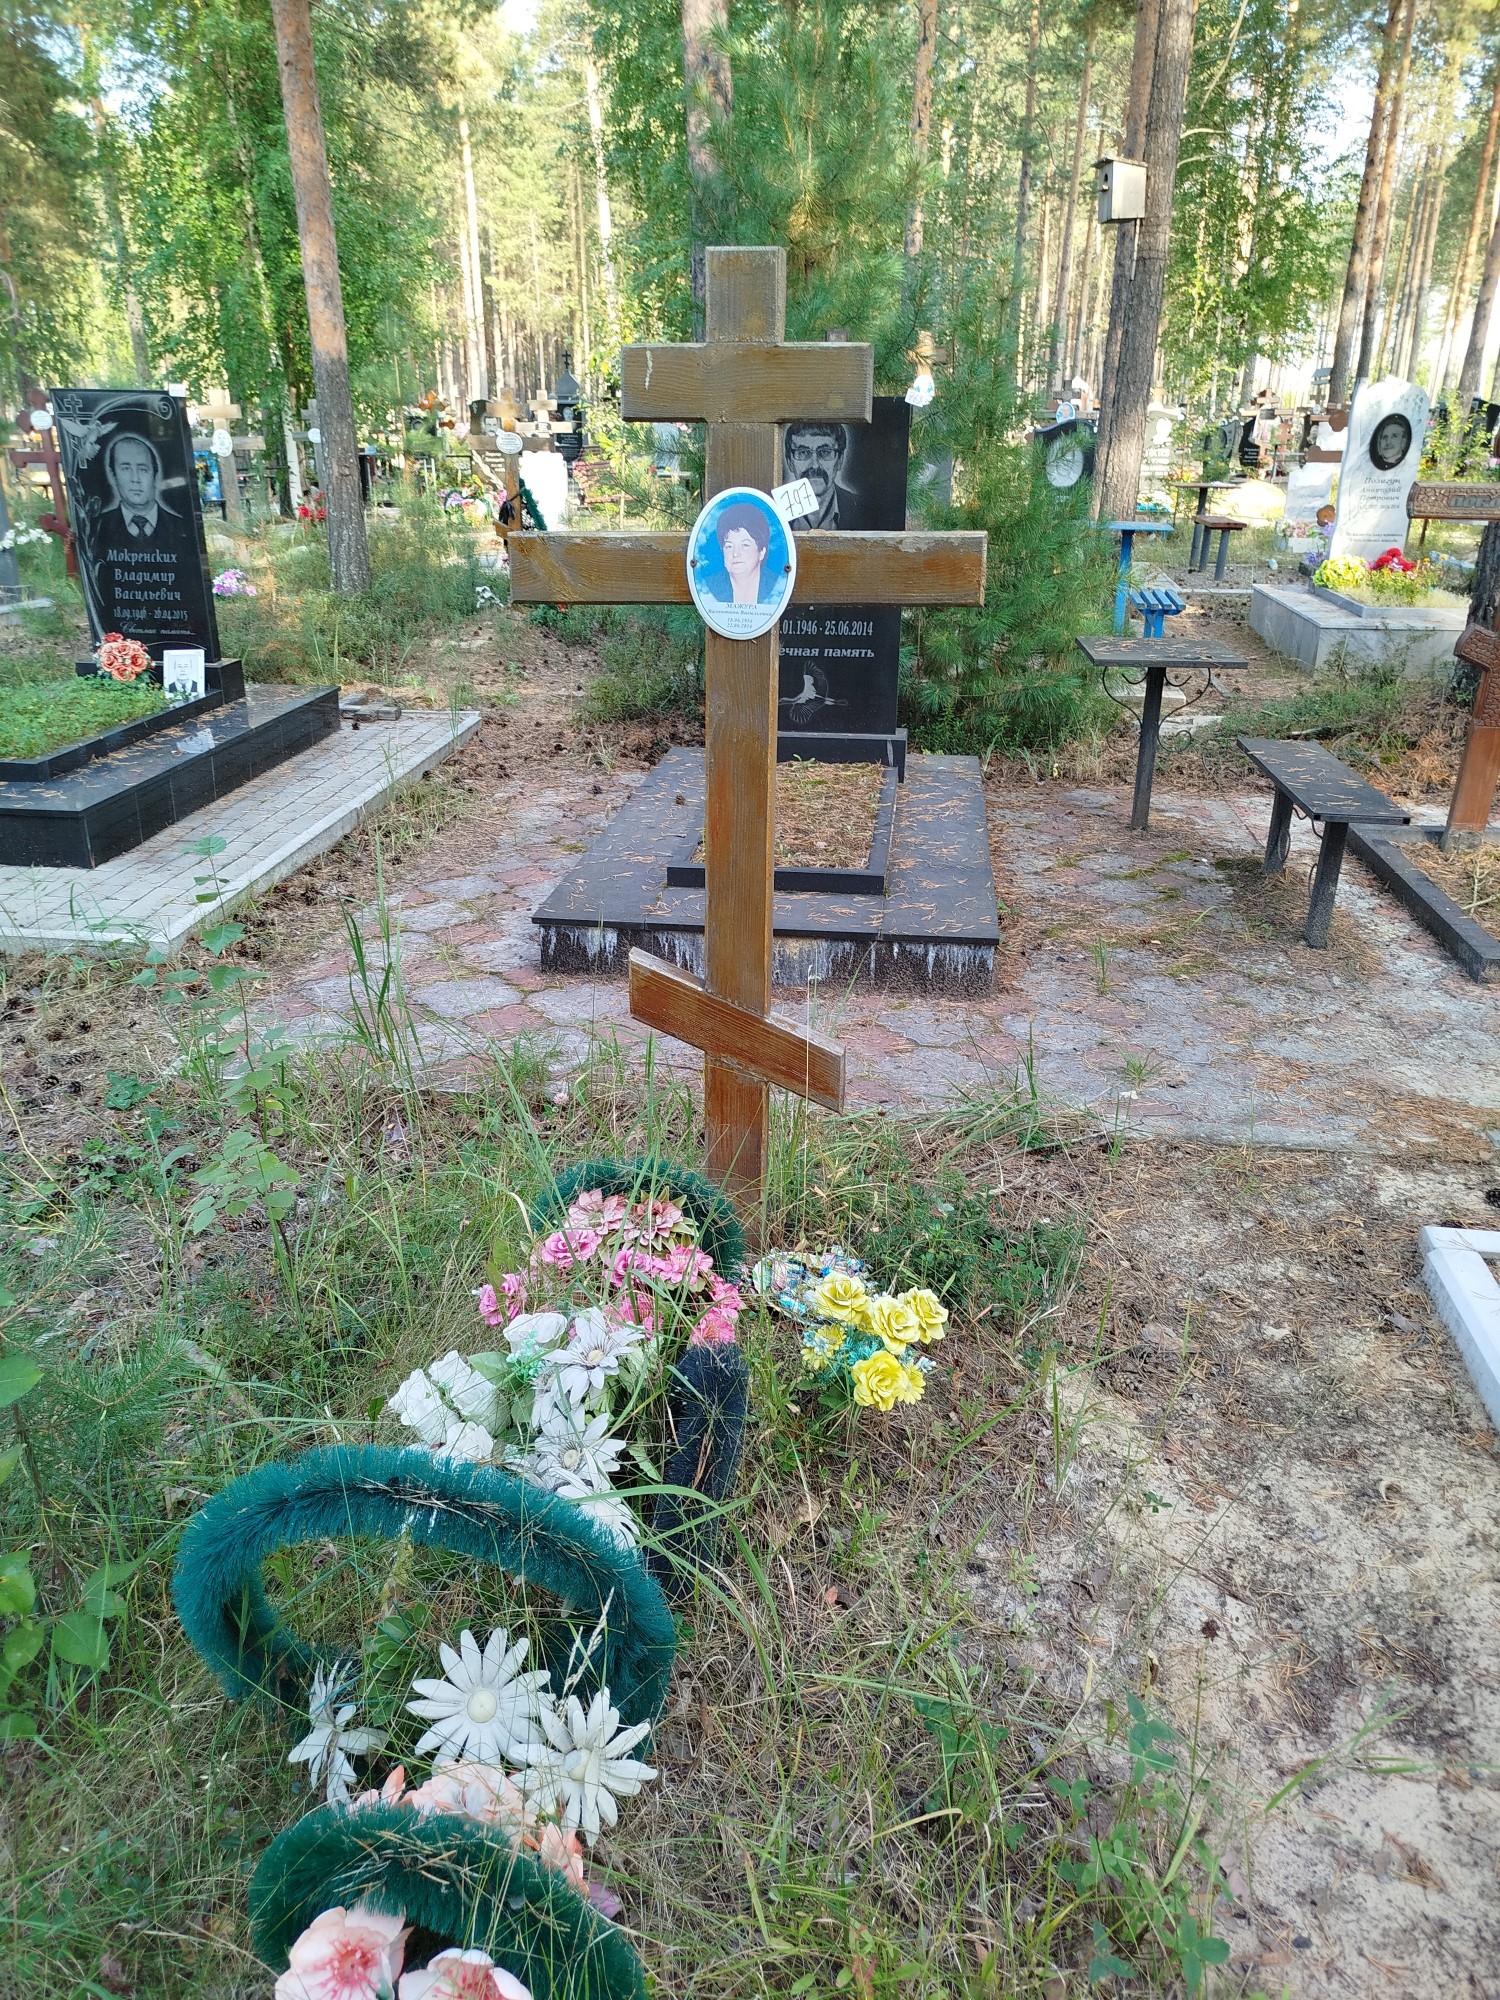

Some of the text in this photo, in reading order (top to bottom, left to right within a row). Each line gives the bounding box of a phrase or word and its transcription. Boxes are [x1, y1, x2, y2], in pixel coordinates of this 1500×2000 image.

[780, 482, 812, 518] 797
[107, 549, 177, 565] Мокренских
[114, 568, 175, 585] Владимир
[114, 587, 181, 601] Васильевич
[779, 619, 818, 636] .01.1946
[824, 620, 873, 636] 25.06.2014
[779, 647, 875, 658] ечная память
